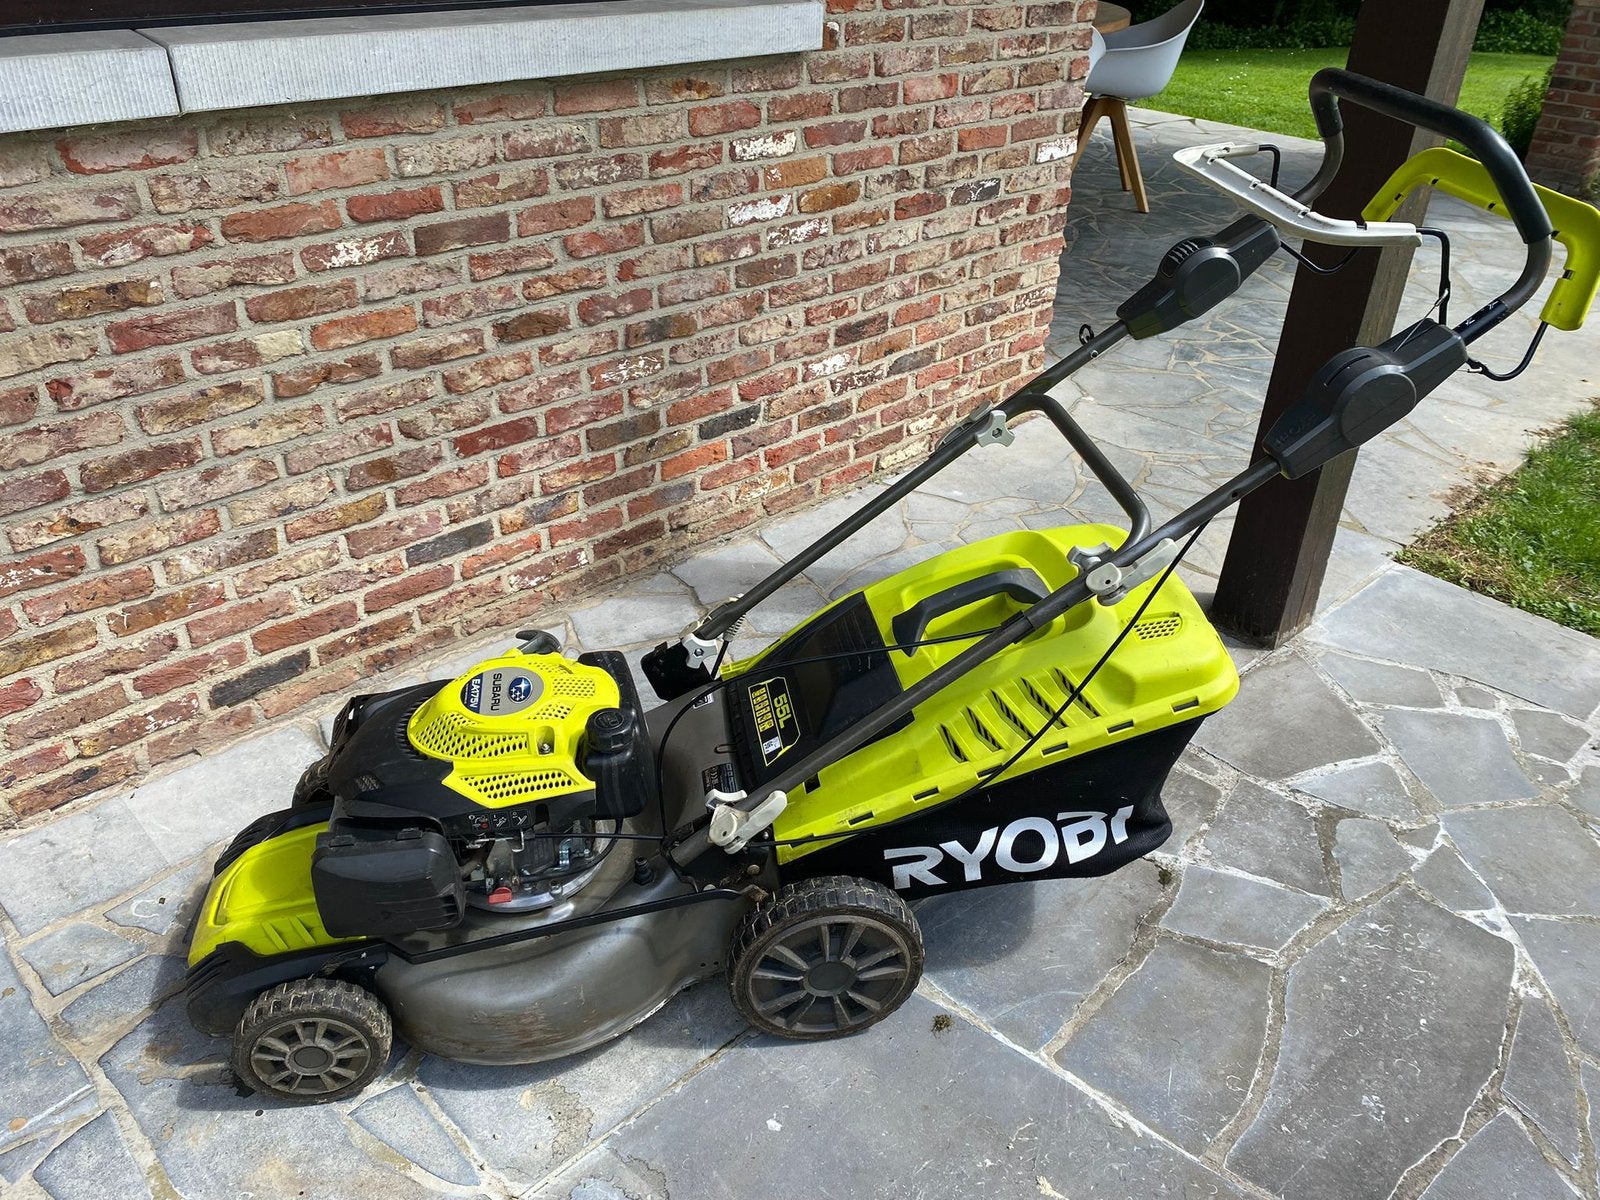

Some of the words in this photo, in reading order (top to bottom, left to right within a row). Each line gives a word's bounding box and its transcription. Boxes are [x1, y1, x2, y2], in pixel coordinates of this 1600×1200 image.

[491, 673, 502, 712] SUBARU
[773, 693, 791, 729] 55L
[884, 805, 1134, 890] RYOBI
